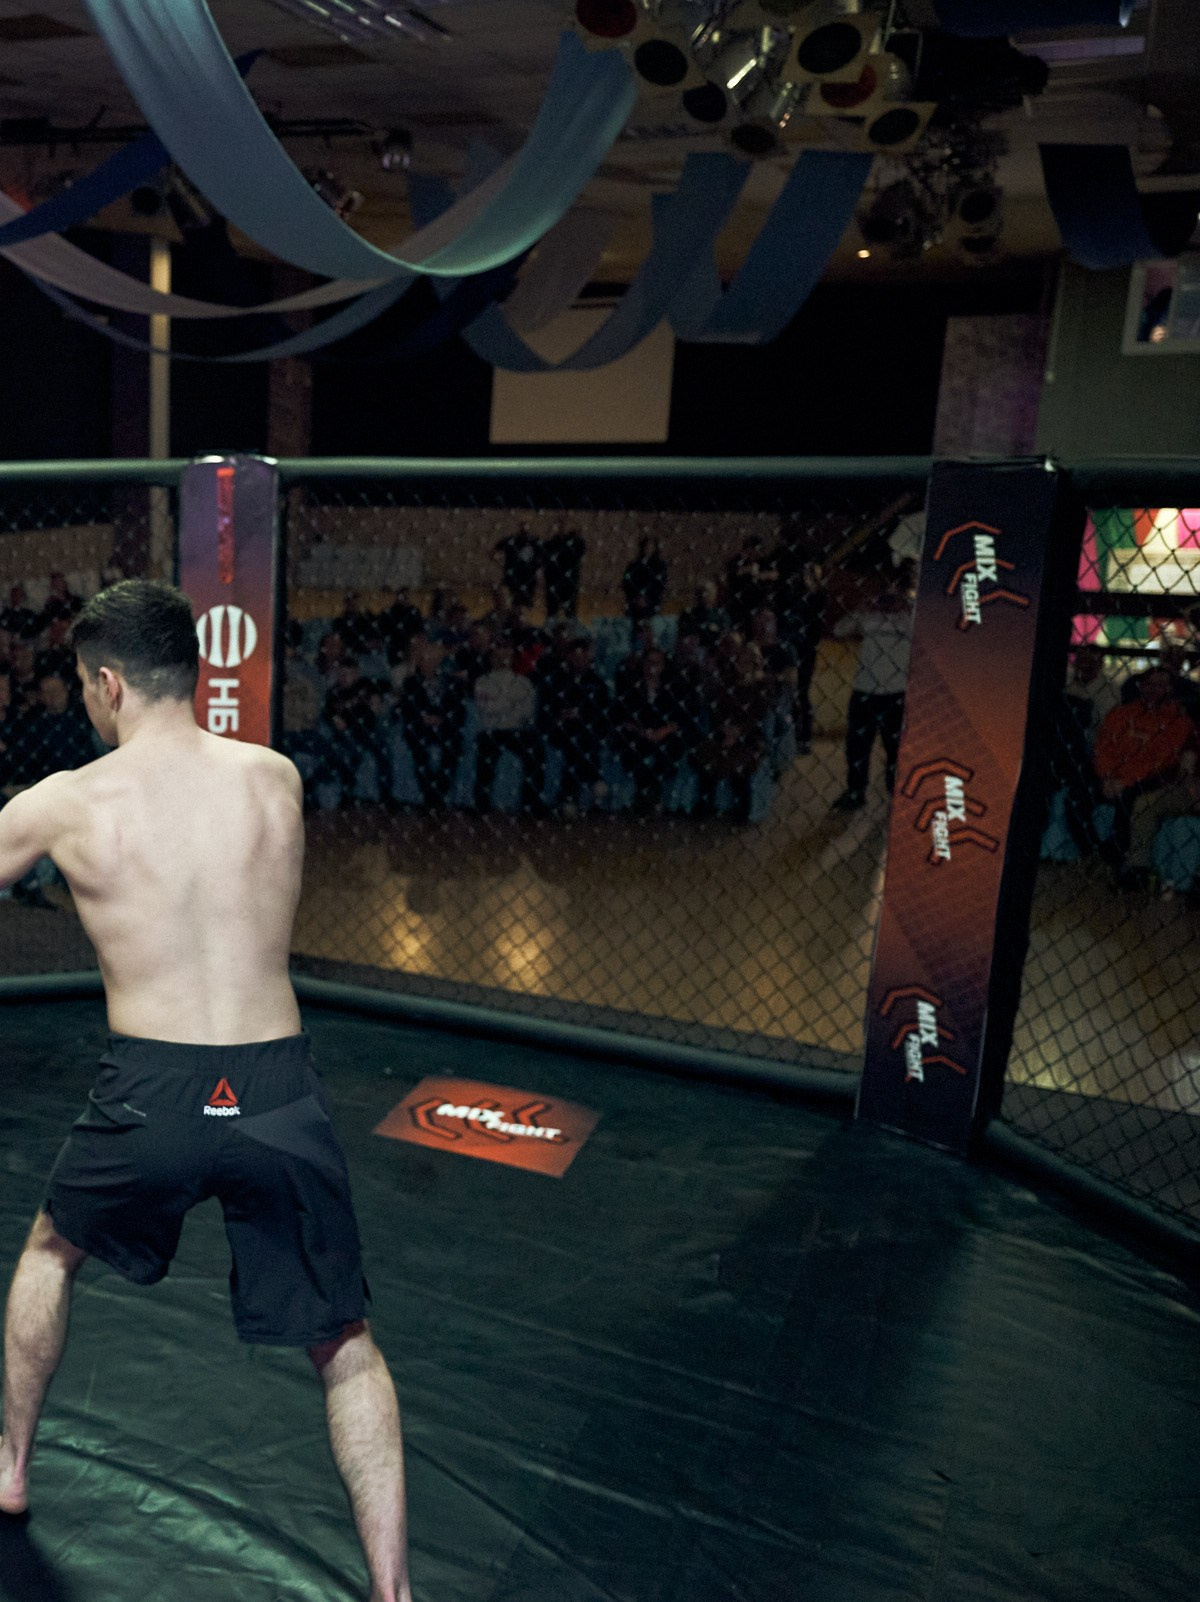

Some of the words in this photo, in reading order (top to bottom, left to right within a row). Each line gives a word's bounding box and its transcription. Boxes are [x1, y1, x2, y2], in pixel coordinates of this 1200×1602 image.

[974, 534, 999, 583] MIX
[960, 572, 981, 625] FIGHT
[944, 775, 966, 823] MIX
[931, 810, 951, 861] FIGHT
[916, 1000, 939, 1049] MIX
[904, 1032, 925, 1083] FIGHT
[203, 1105, 241, 1117] Reebok
[437, 1103, 505, 1122] MIX
